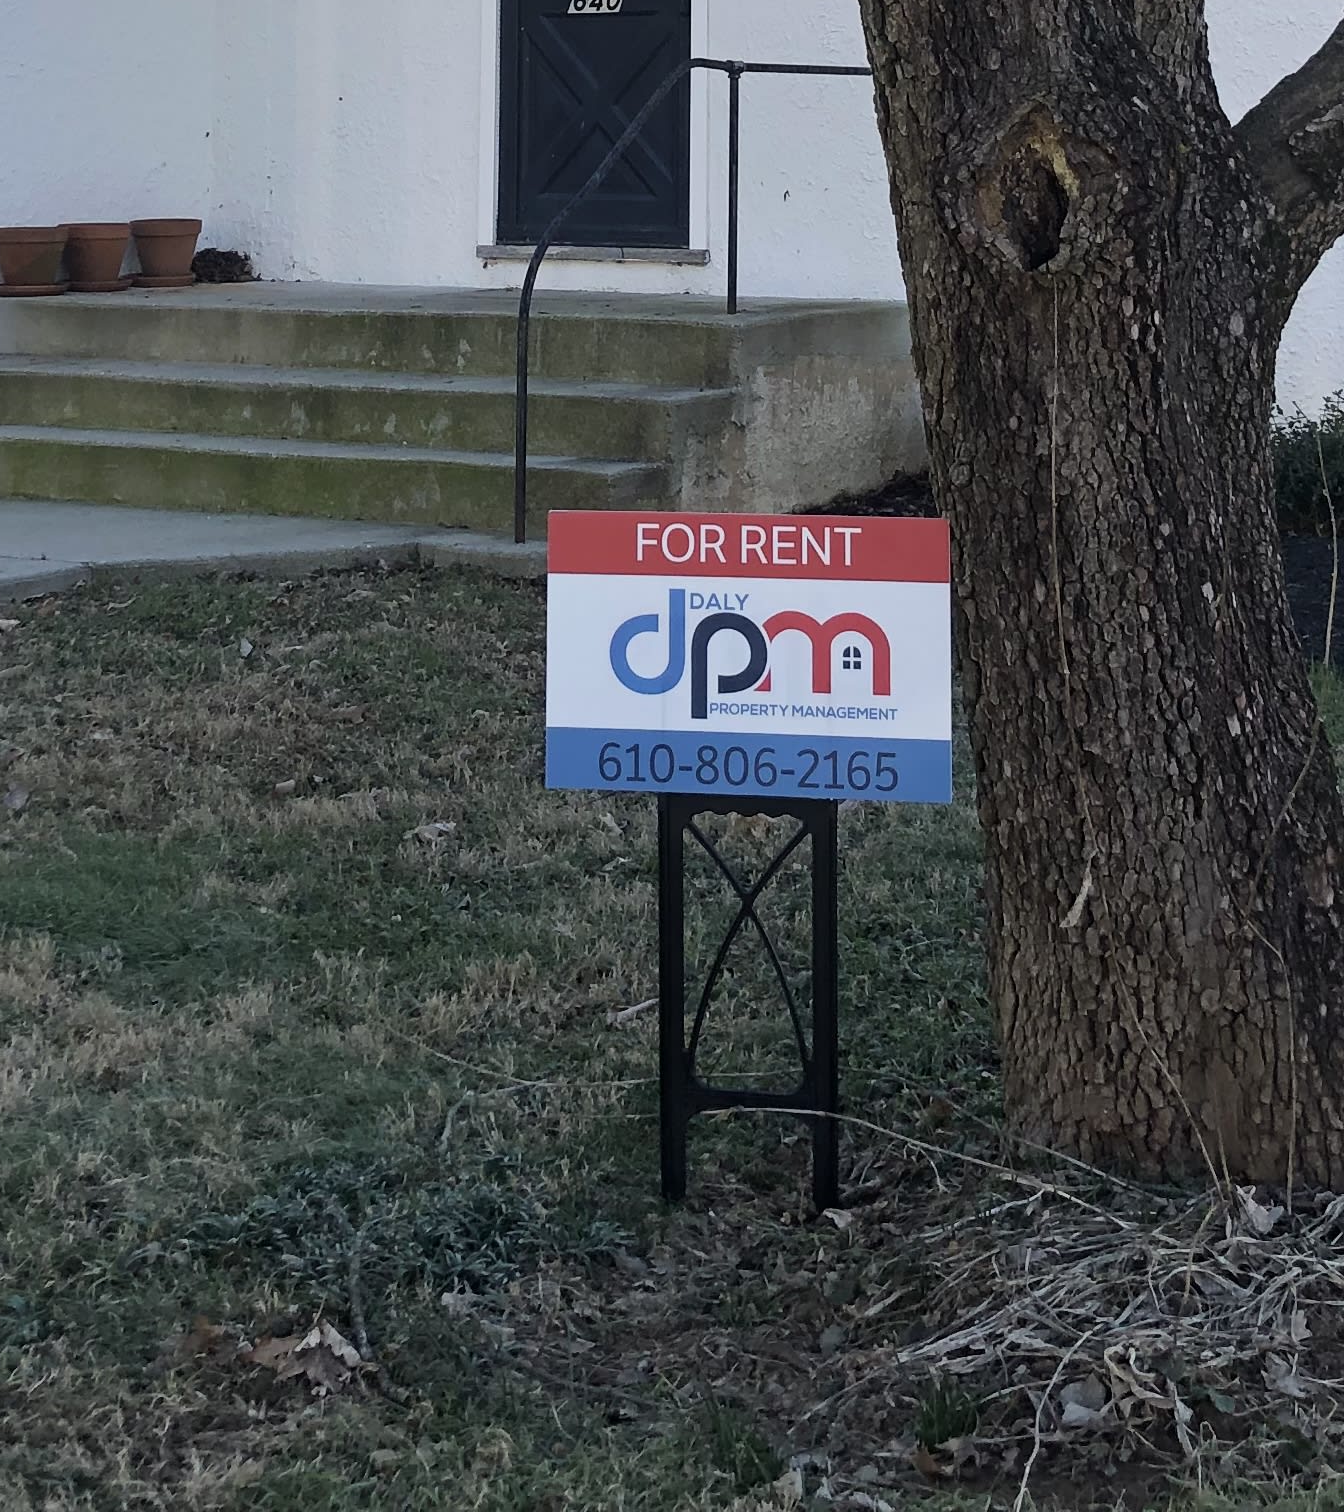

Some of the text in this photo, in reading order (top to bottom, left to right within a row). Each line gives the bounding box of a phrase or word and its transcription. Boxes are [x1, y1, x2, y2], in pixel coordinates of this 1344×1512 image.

[635, 522, 863, 566] FOR RENT
[689, 592, 750, 611] DALY
[609, 588, 892, 720] dpm
[709, 702, 898, 721] PROPERTY MANAGEMENT
[598, 741, 899, 792] 610-806-2165
